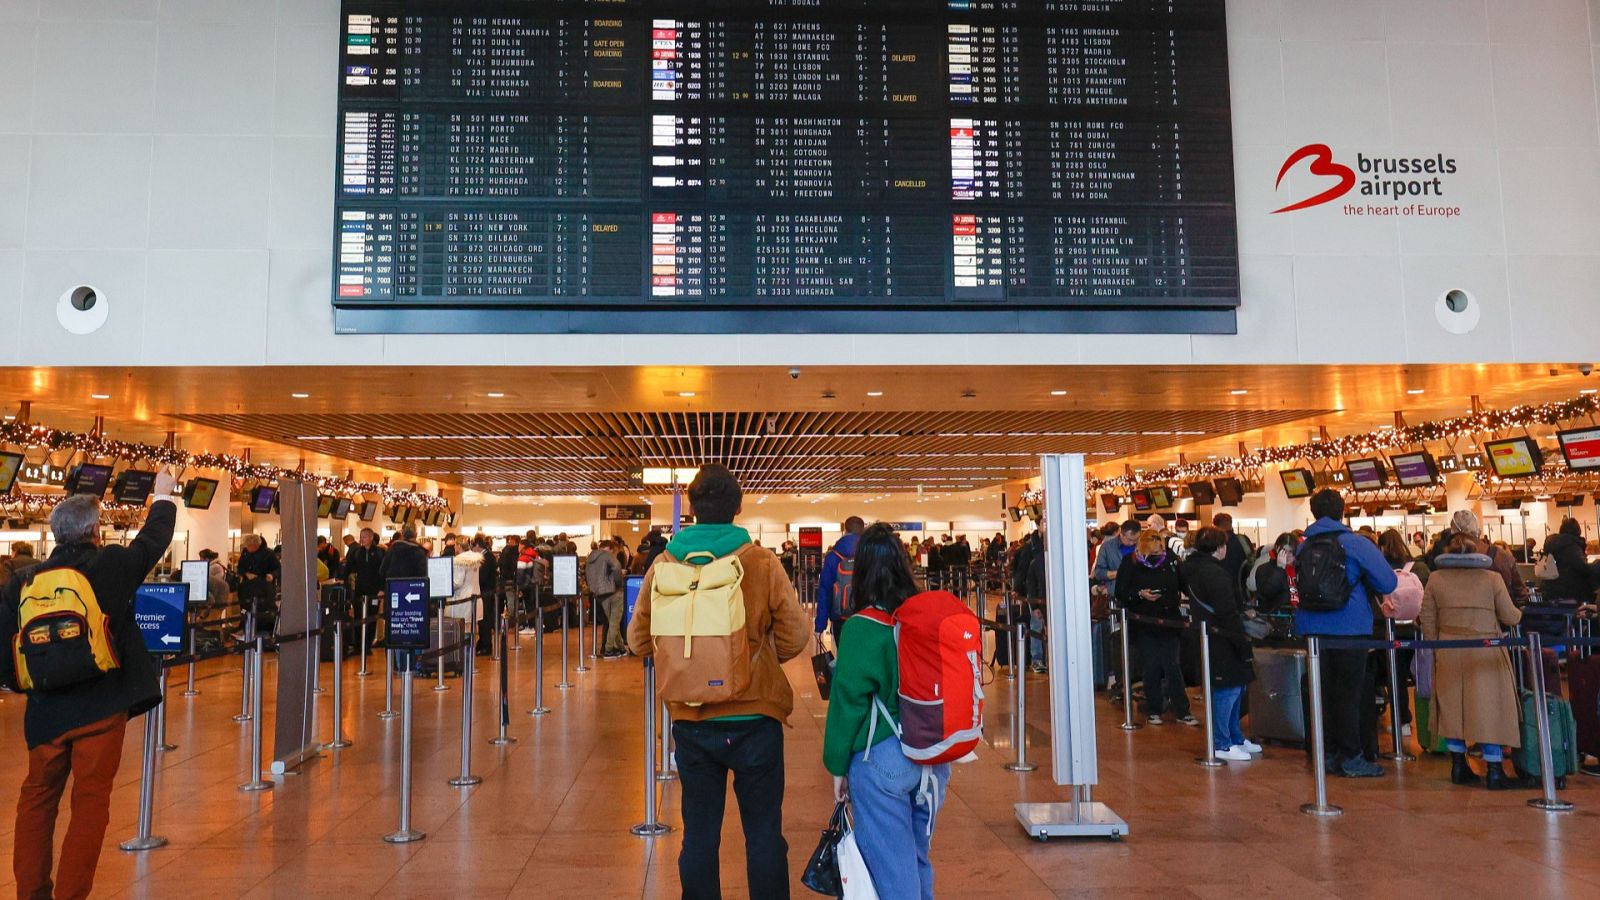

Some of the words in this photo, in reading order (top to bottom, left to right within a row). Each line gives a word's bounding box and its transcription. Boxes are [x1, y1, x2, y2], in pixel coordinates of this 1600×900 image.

[492, 48, 524, 56] ENTEBBE
[1062, 48, 1080, 56] 3727
[1084, 58, 1126, 66] STOCKHOLM
[770, 92, 788, 100] 3737
[490, 136, 508, 144] NICE
[466, 146, 484, 154] 1172
[794, 148, 826, 156] COTONOU
[1357, 152, 1457, 174] brussels
[490, 166, 524, 174] BOLOGNA
[1090, 182, 1112, 190] CAIRO
[1360, 175, 1443, 200] airport
[1344, 204, 1364, 216] the
[1367, 204, 1399, 216] heart
[1402, 204, 1416, 216] of
[1418, 204, 1460, 218] Europe
[1092, 216, 1126, 224] ISTANBUL
[508, 224, 528, 232] YORK
[794, 226, 838, 234] BARCELONA
[776, 236, 790, 244] 555
[488, 244, 522, 252] CHICAGO
[528, 244, 542, 252] ORD
[824, 256, 832, 264] EL
[838, 256, 852, 264] SHE
[462, 266, 482, 274] 5297
[488, 266, 532, 274] MARRAKECH
[1092, 268, 1128, 276] TOULOUSE
[135, 613, 166, 622] Premier
